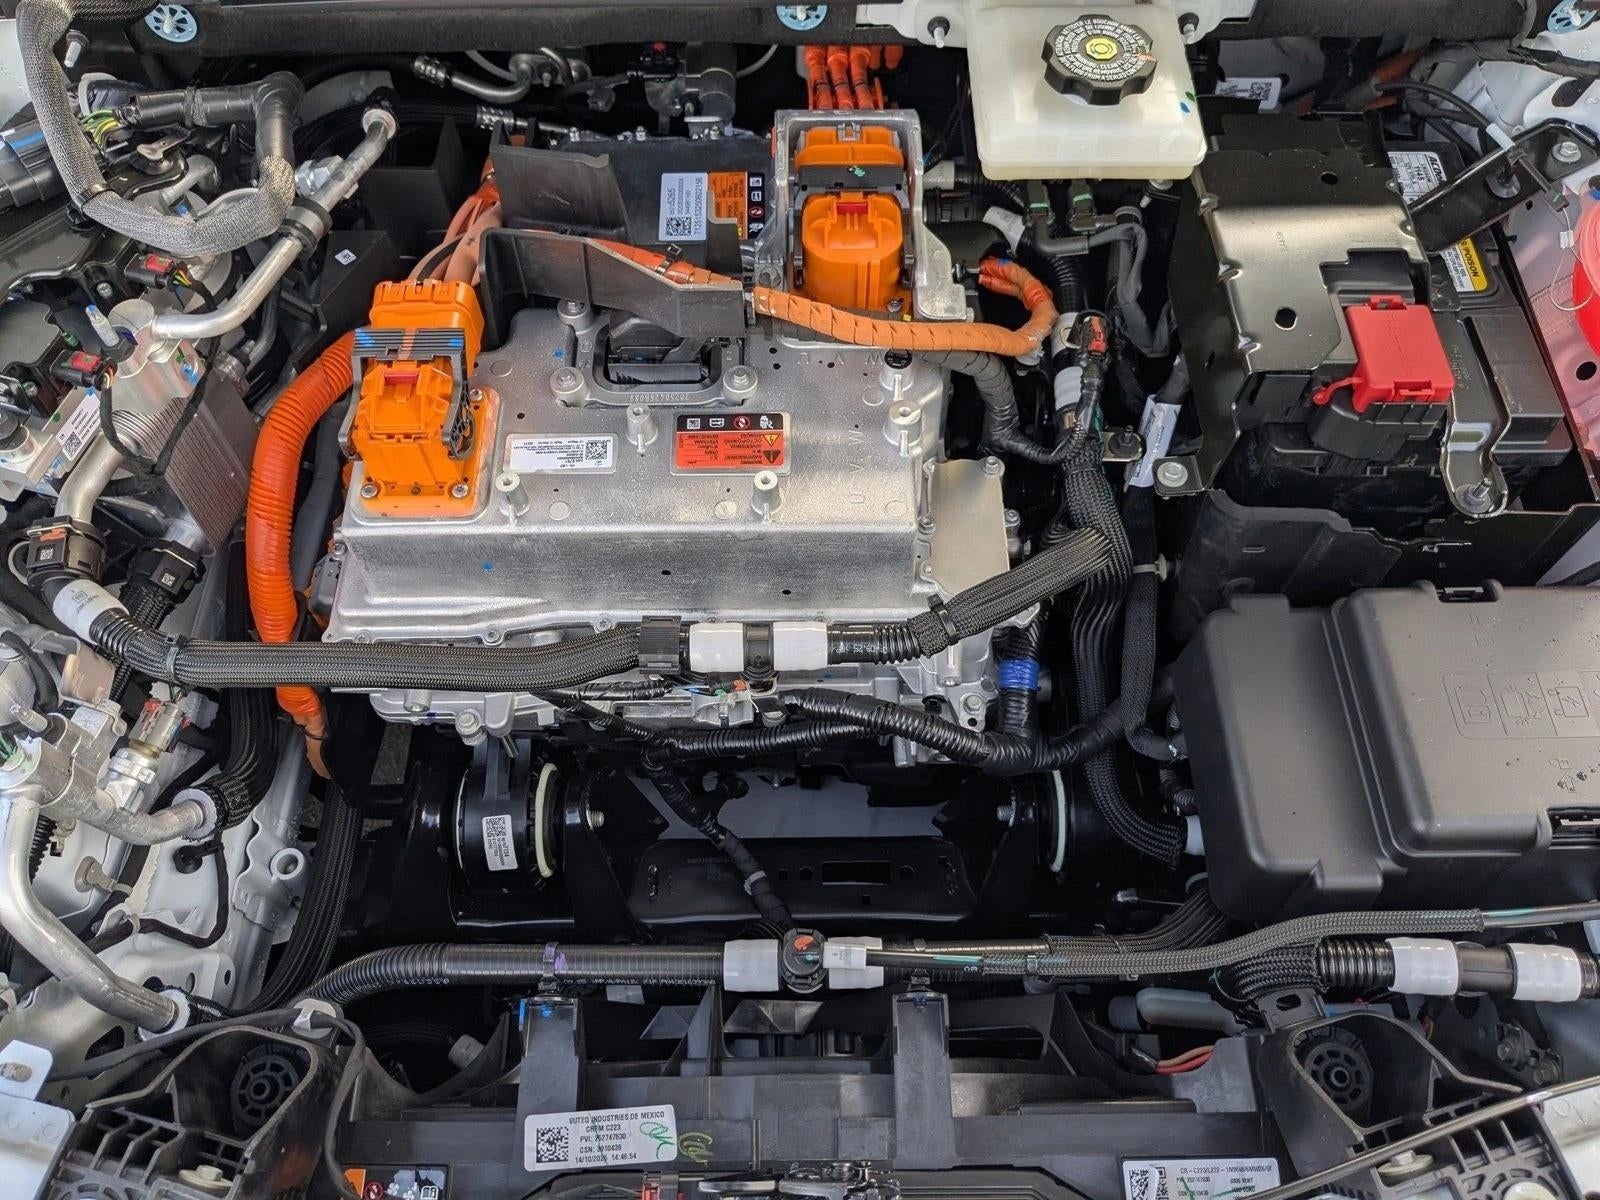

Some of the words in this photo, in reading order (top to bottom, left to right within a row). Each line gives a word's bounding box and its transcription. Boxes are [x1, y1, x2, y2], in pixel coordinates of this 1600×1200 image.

[1414, 165, 1423, 182] 1145
[591, 1113, 628, 1123] INDUSTRIES
[640, 1111, 665, 1119] MEXICO
